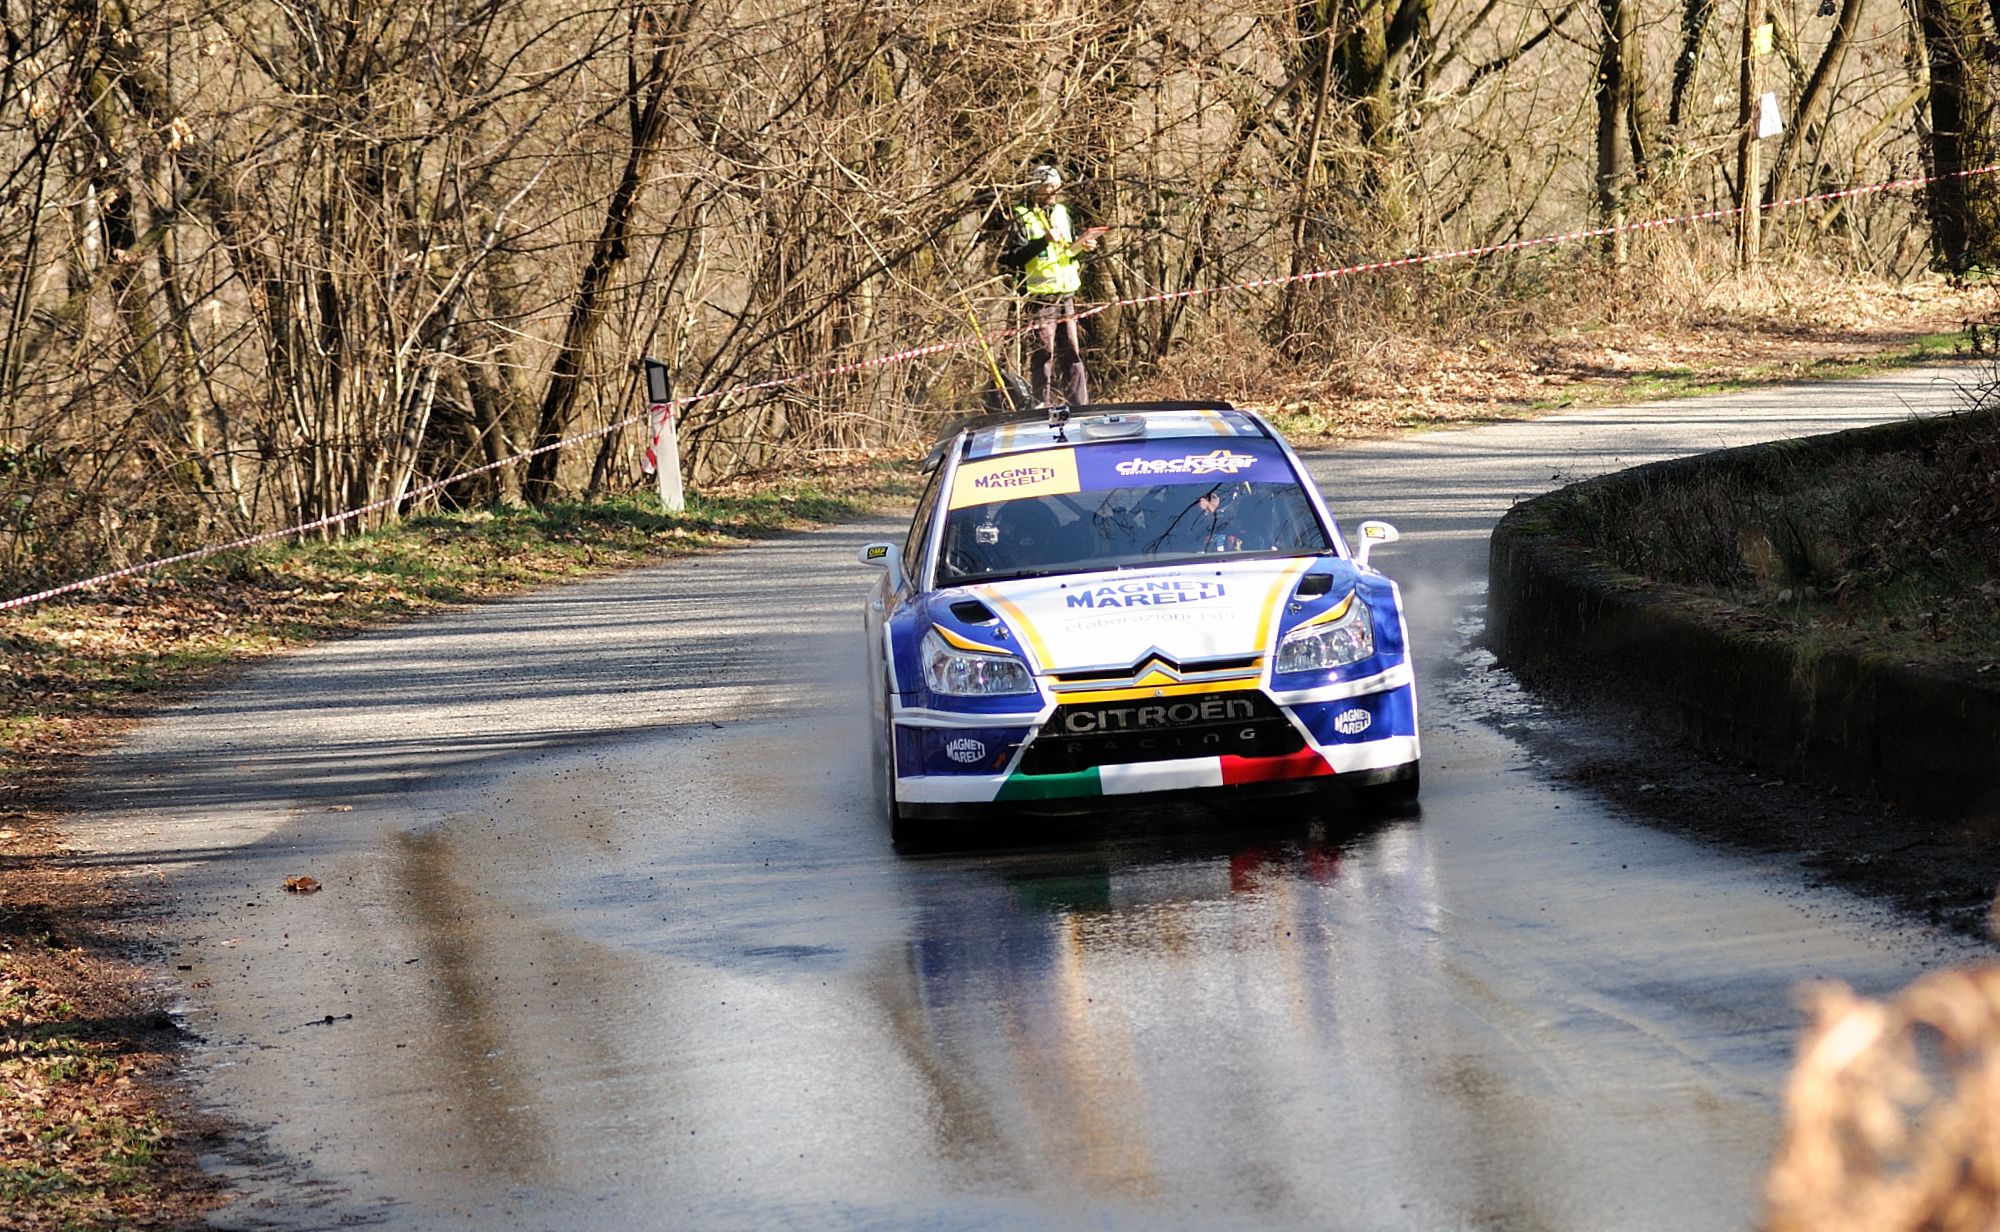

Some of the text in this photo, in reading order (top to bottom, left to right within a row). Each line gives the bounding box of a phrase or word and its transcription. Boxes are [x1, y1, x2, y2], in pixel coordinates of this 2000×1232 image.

[1115, 455, 1258, 472] checkstar
[975, 467, 1055, 482] MAGNETI
[975, 474, 1055, 488] MARELLI
[869, 547, 885, 555] OMP
[1066, 581, 1226, 602] MAGNETI
[1066, 592, 1226, 608] MARELLI
[1334, 708, 1371, 724] MAGNETI
[1334, 719, 1371, 734] MARELLI
[946, 738, 986, 752] MAGNETI
[946, 749, 986, 763] MARELLI
